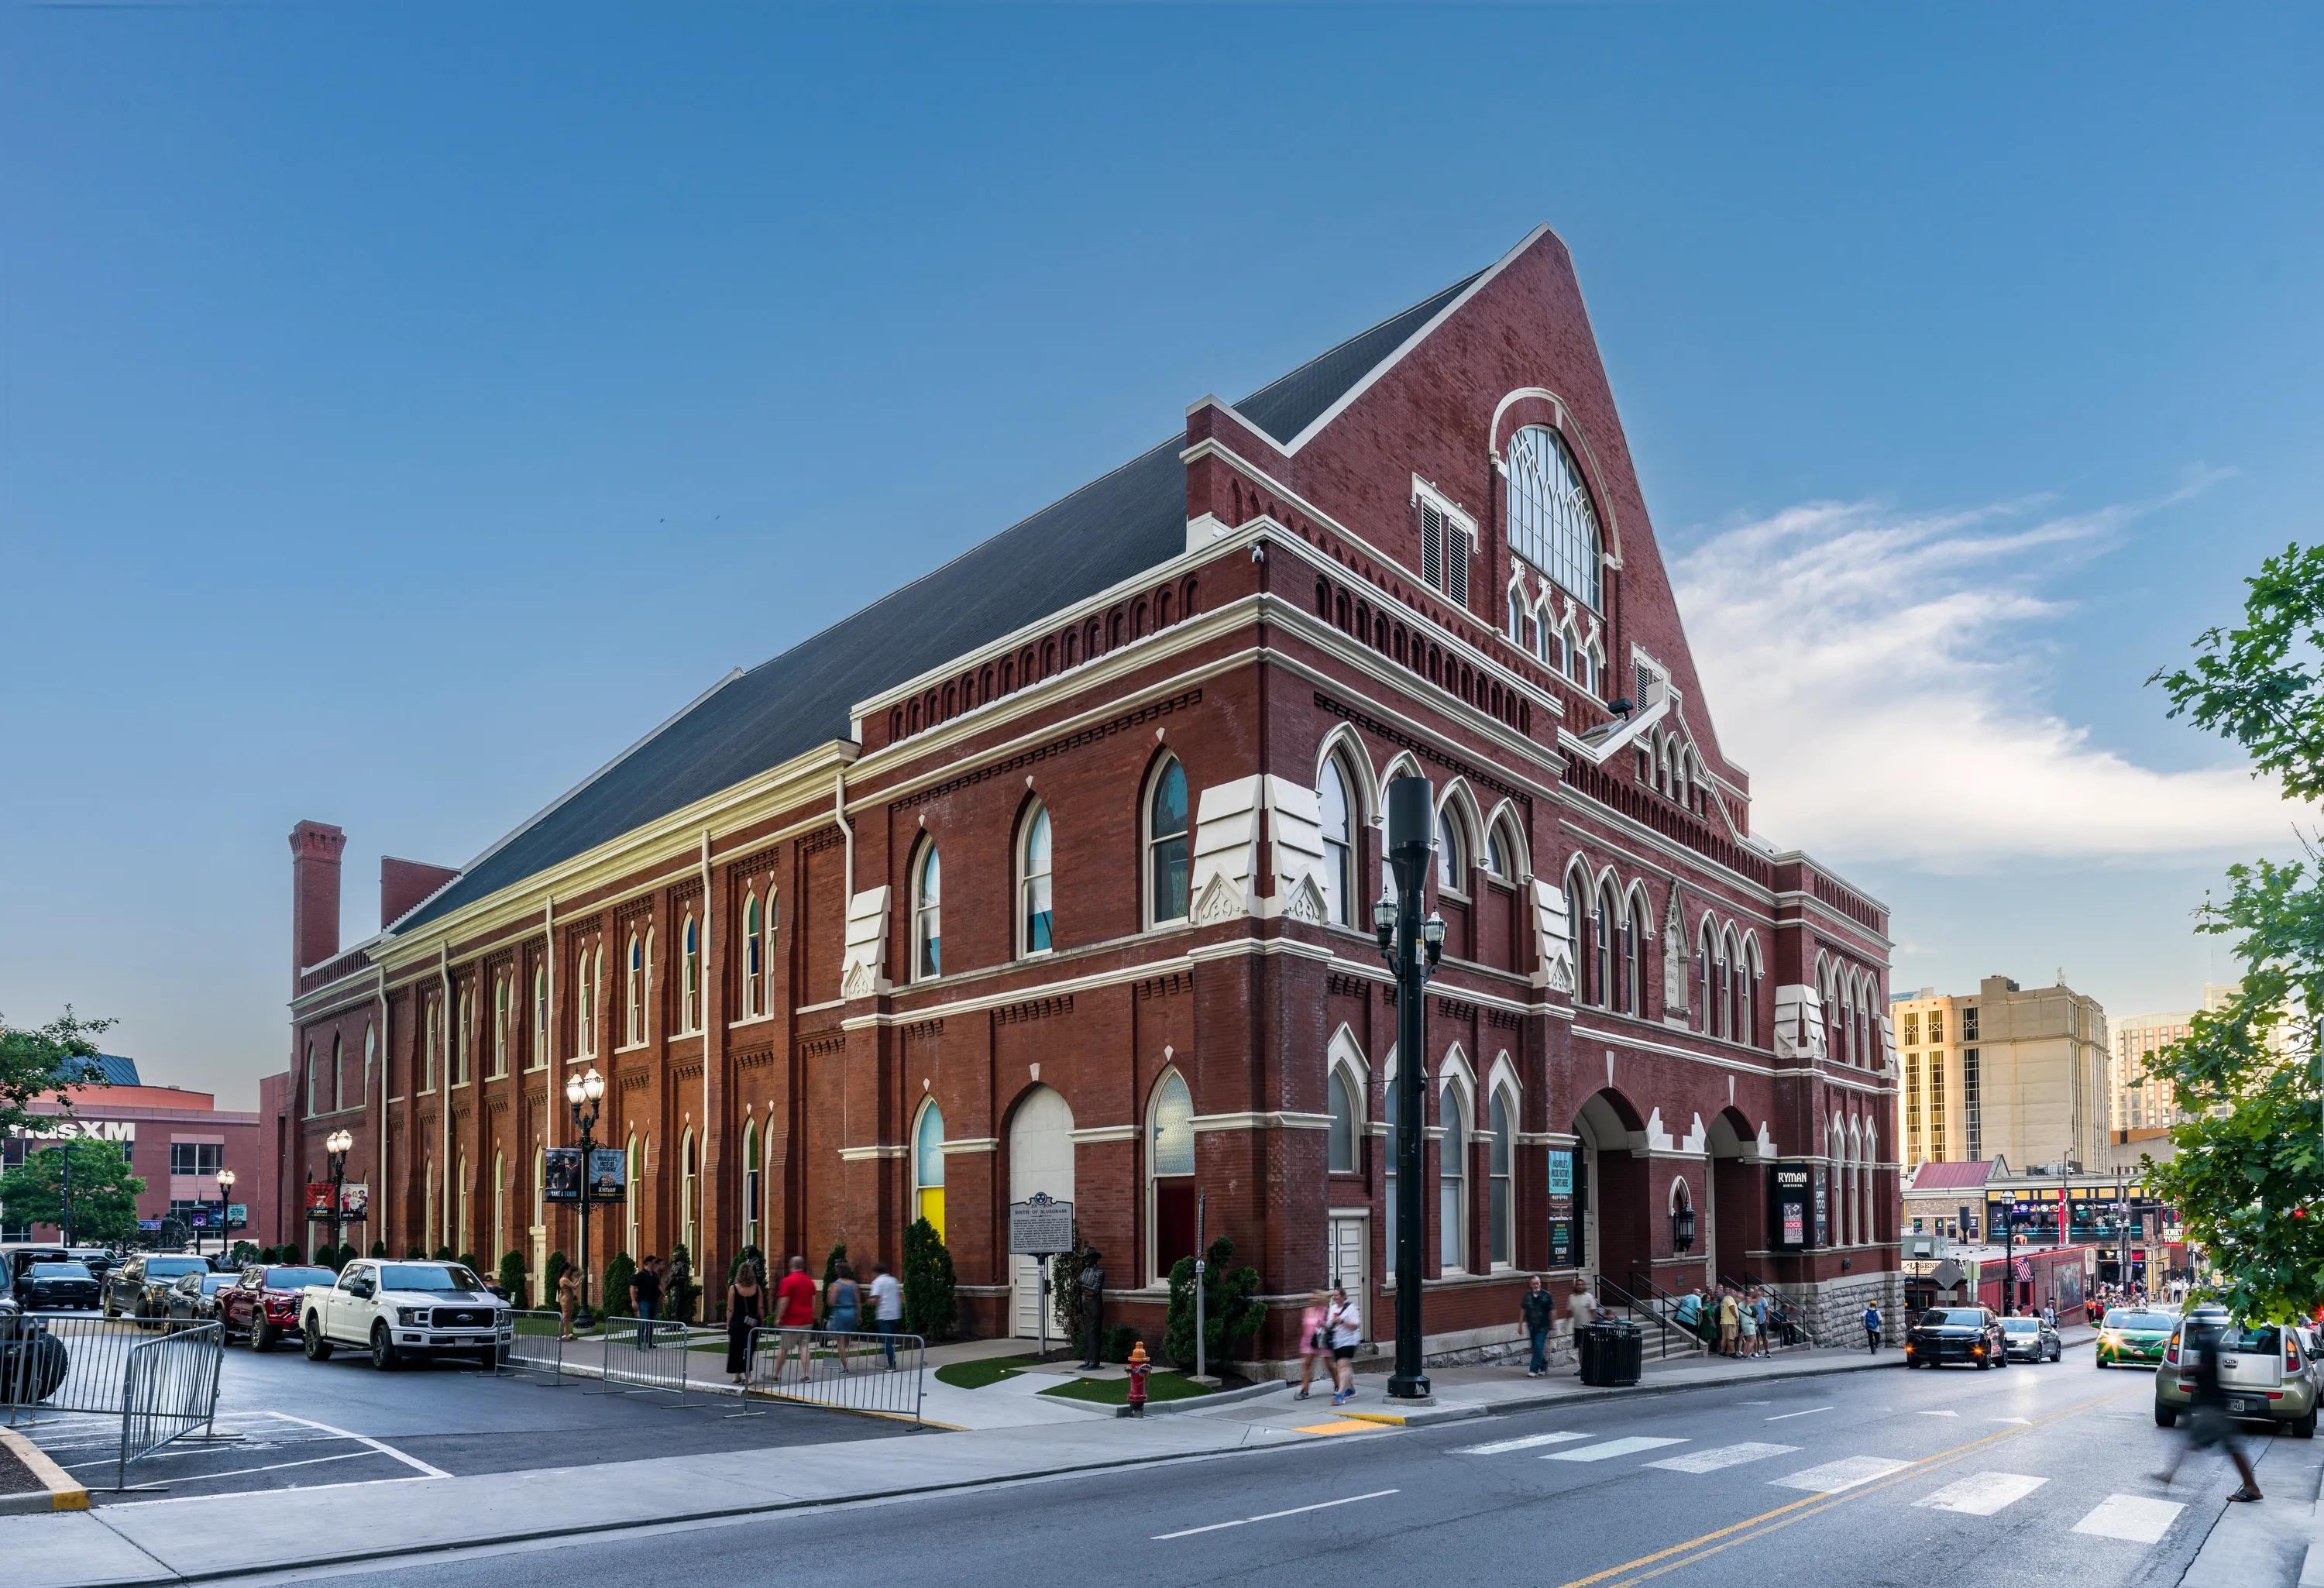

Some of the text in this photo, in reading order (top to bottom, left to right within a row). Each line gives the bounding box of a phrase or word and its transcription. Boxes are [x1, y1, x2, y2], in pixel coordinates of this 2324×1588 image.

[1778, 1172, 1807, 1183] RYMAN
[1816, 1191, 1825, 1199] OPRY
[2164, 1228, 2183, 1236] HONKY
